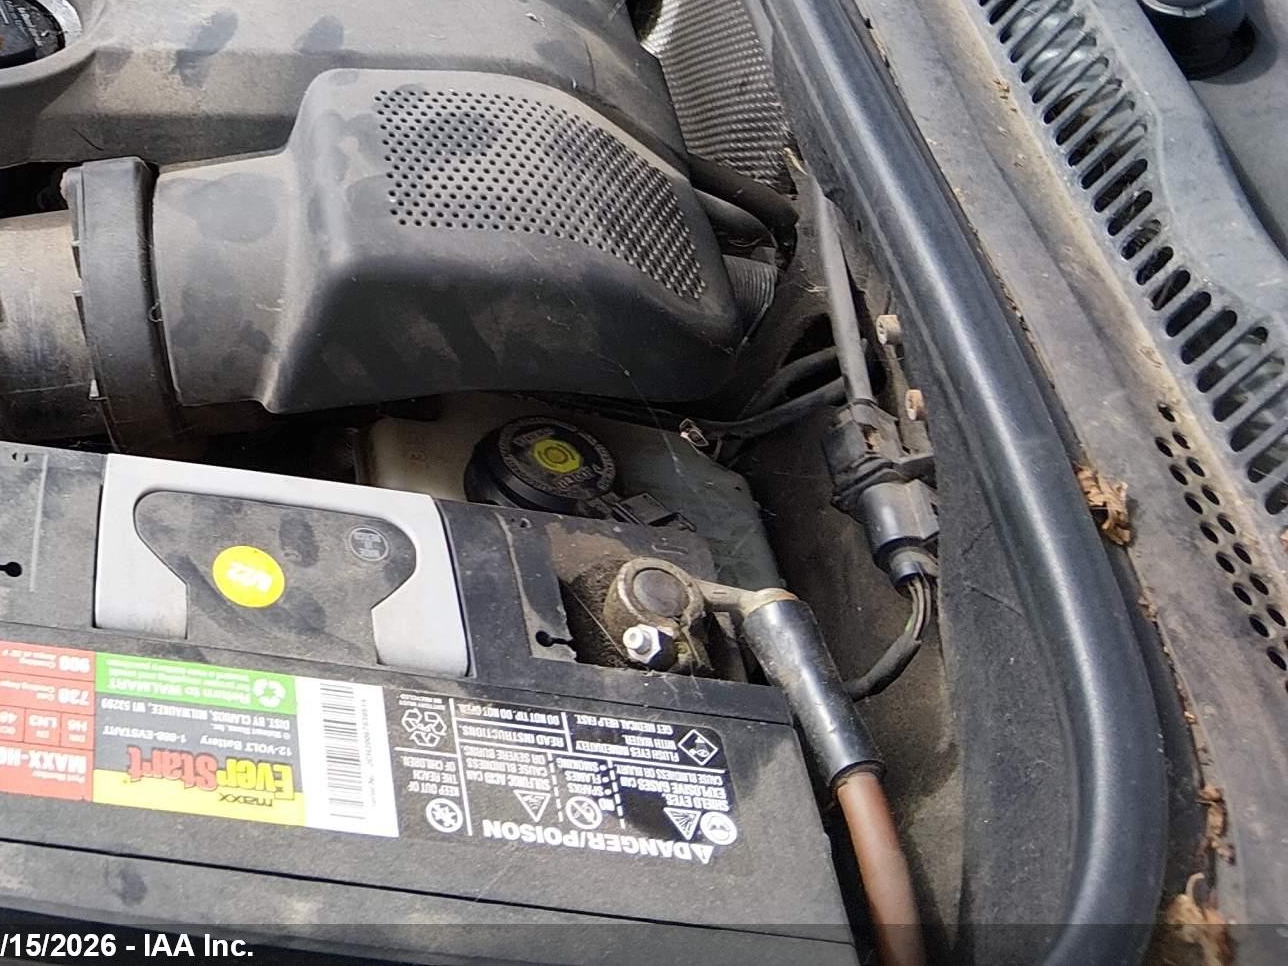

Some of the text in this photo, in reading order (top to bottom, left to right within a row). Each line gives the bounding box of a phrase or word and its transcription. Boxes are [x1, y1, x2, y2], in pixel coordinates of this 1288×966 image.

[108, 676, 182, 696] WALMART
[185, 686, 199, 697] to
[203, 688, 248, 703] Return
[253, 716, 263, 726] BY
[547, 713, 559, 725] DO
[656, 723, 672, 735] GET
[200, 734, 292, 756] 12-VOLT Battery
[536, 733, 563, 747] READ
[496, 748, 529, 763] SEVERE
[517, 762, 547, 777] CAUSE
[556, 756, 597, 772] SMOKING
[127, 745, 294, 801] EverStart
[413, 768, 457, 784] THE REACH
[484, 771, 505, 784] ACID
[565, 769, 600, 784] FLAMES
[420, 781, 436, 794] OUT
[439, 783, 459, 796] KEEP
[568, 781, 602, 796] SPARKS
[638, 777, 669, 792] GASES
[671, 780, 725, 799] EXPLOSIVE
[218, 792, 272, 807] maxx
[694, 796, 728, 811] SHIELD
[483, 818, 691, 859] DANGER/POISON
